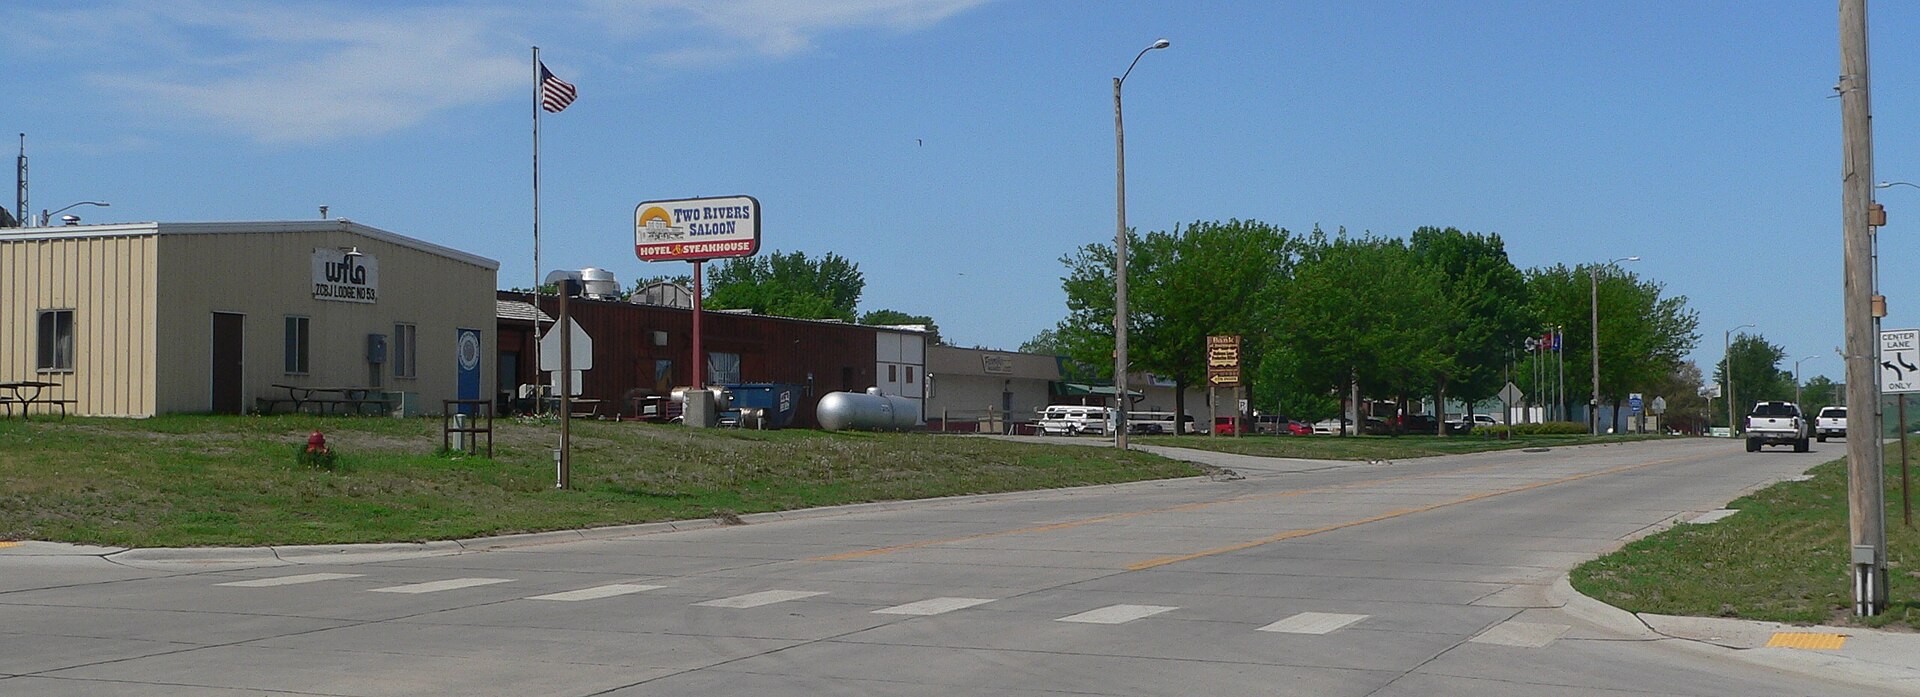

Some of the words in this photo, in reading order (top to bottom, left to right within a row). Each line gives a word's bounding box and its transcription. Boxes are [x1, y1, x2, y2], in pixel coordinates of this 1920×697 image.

[674, 208, 700, 223] TWO
[703, 206, 750, 220] RIVERS
[689, 221, 736, 236] SALOON
[640, 246, 672, 256] HOTEL
[683, 242, 750, 254] STEAKHOUSE
[315, 283, 333, 296] ZCBJ
[334, 285, 356, 299] LODGE
[356, 287, 366, 300] NO
[366, 287, 376, 300] 53
[1882, 333, 1914, 341] CENTER
[1887, 341, 1910, 349] LANE
